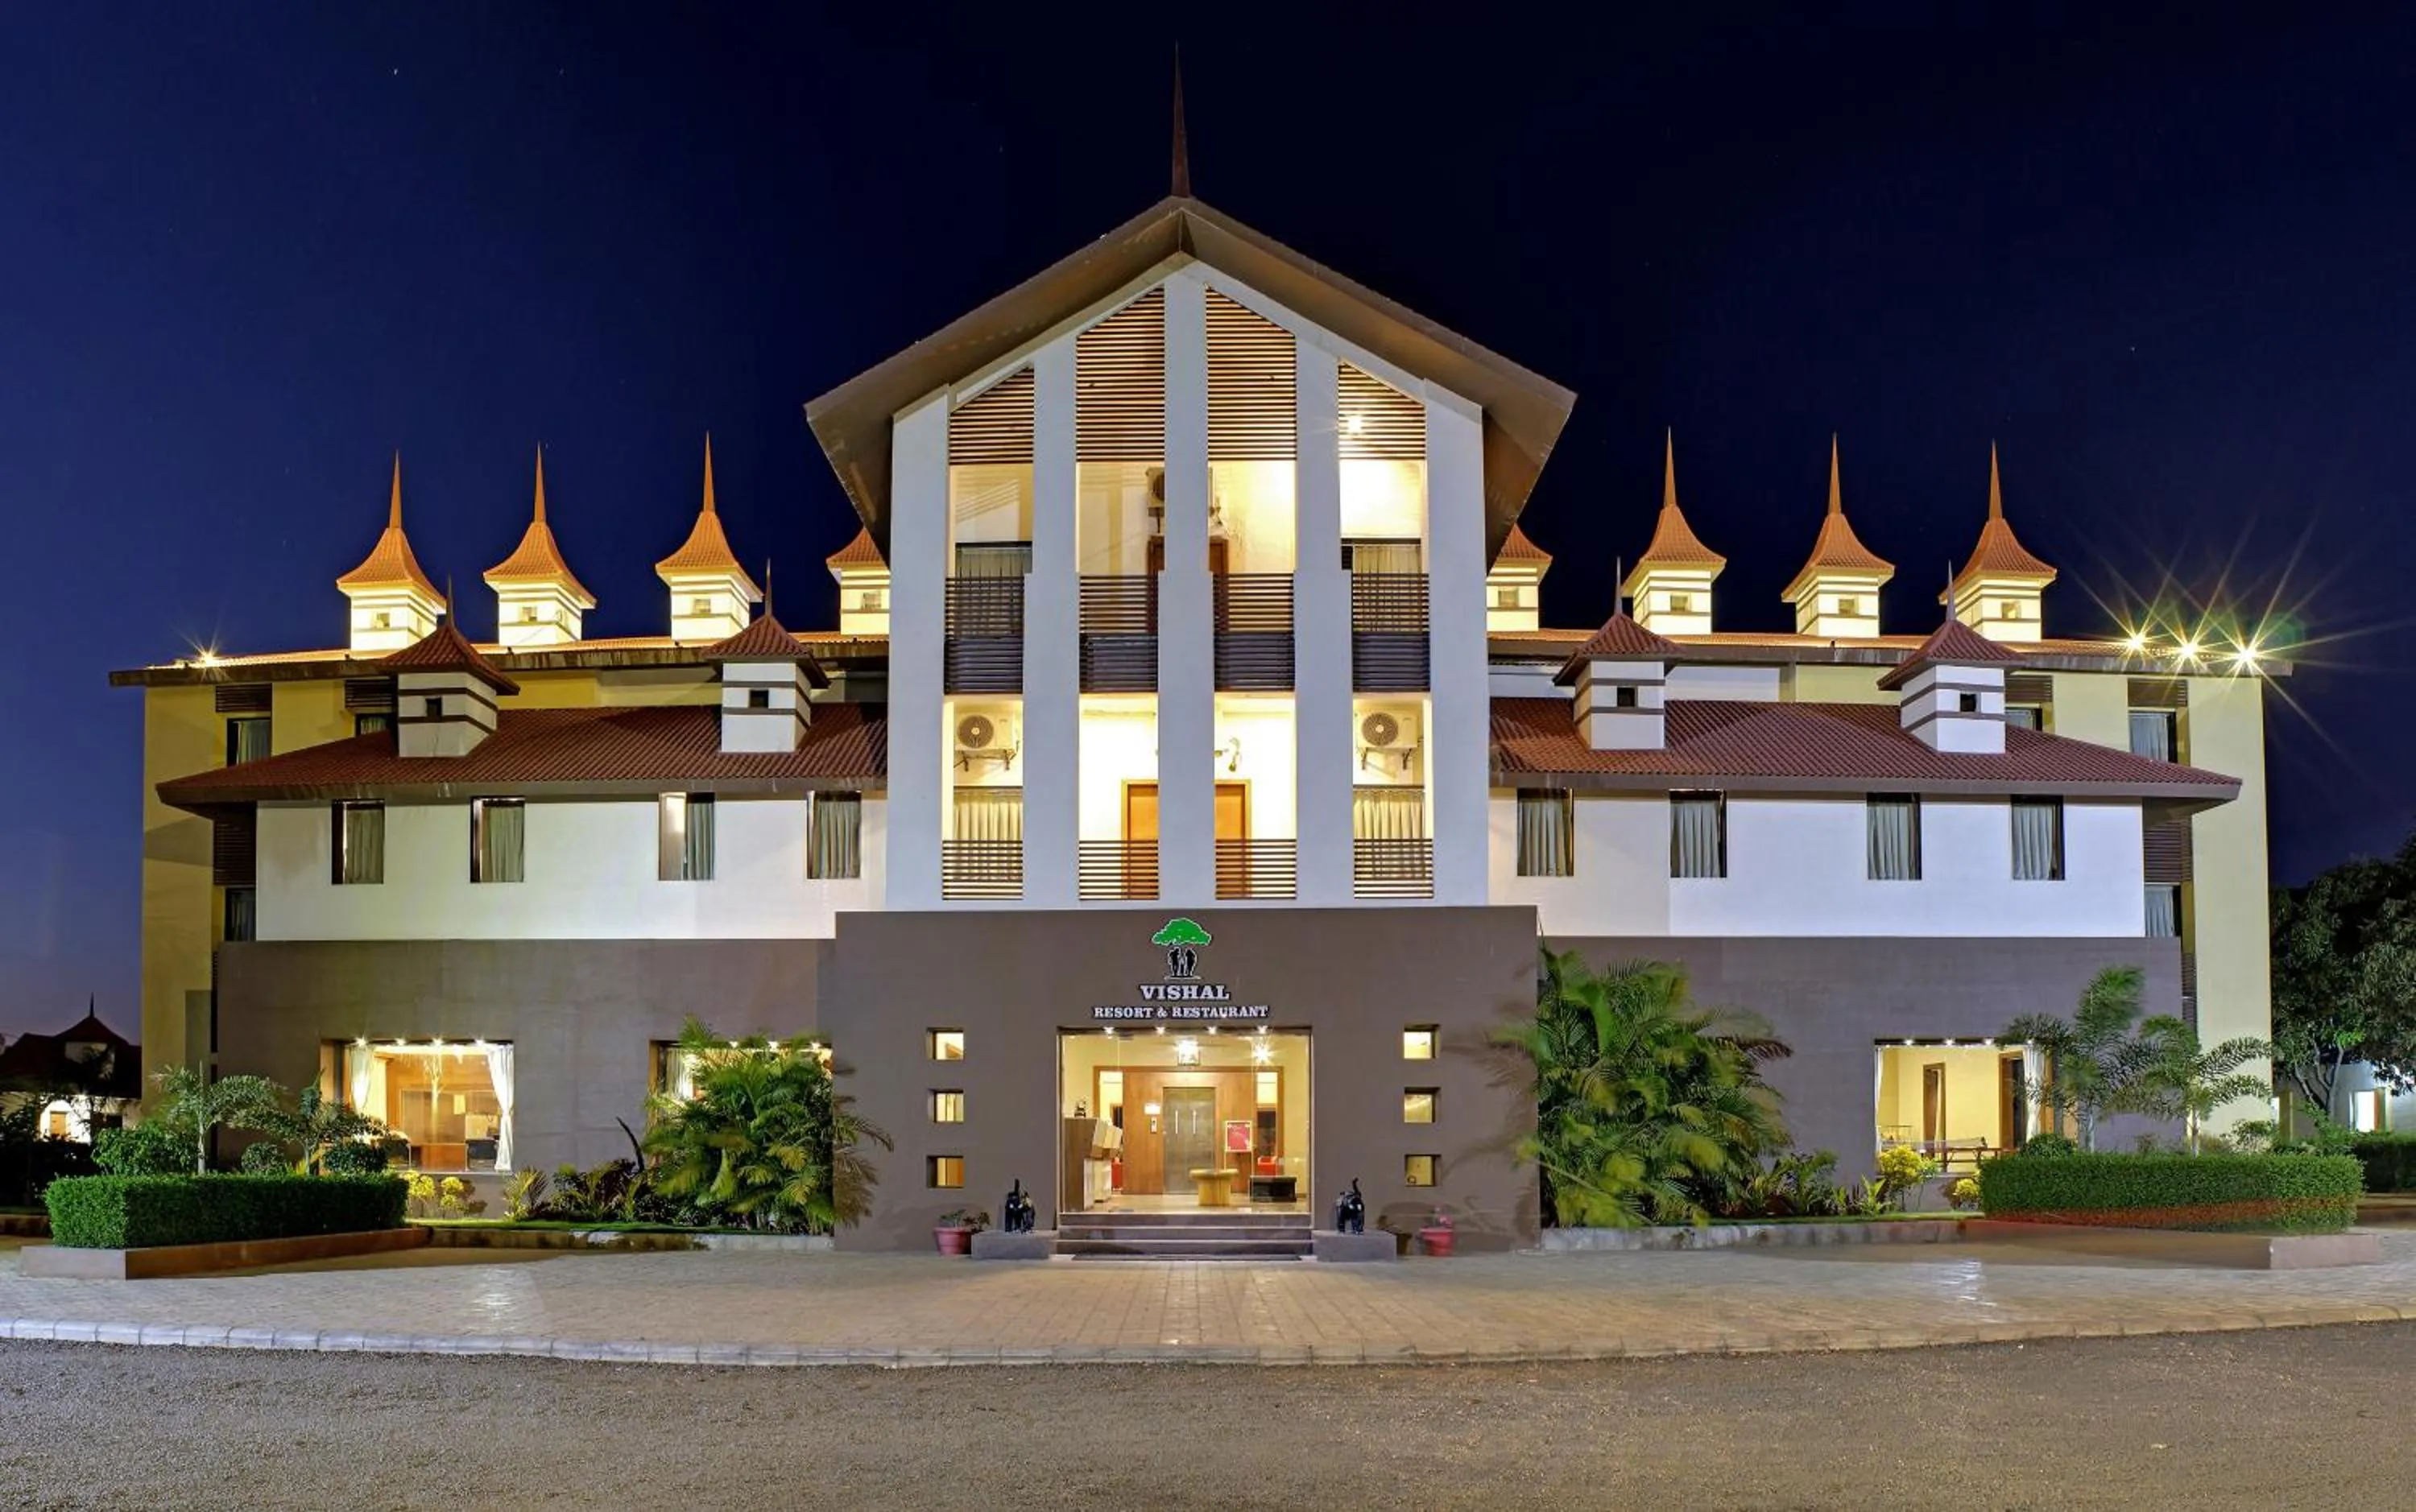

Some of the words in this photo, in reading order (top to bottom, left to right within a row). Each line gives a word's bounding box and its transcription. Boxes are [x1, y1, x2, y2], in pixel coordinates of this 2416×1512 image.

[1140, 985, 1230, 1001] VISHAL
[1094, 1006, 1152, 1018] RESORT
[1156, 1006, 1168, 1018] &
[1172, 1006, 1268, 1018] RESTAURANT
